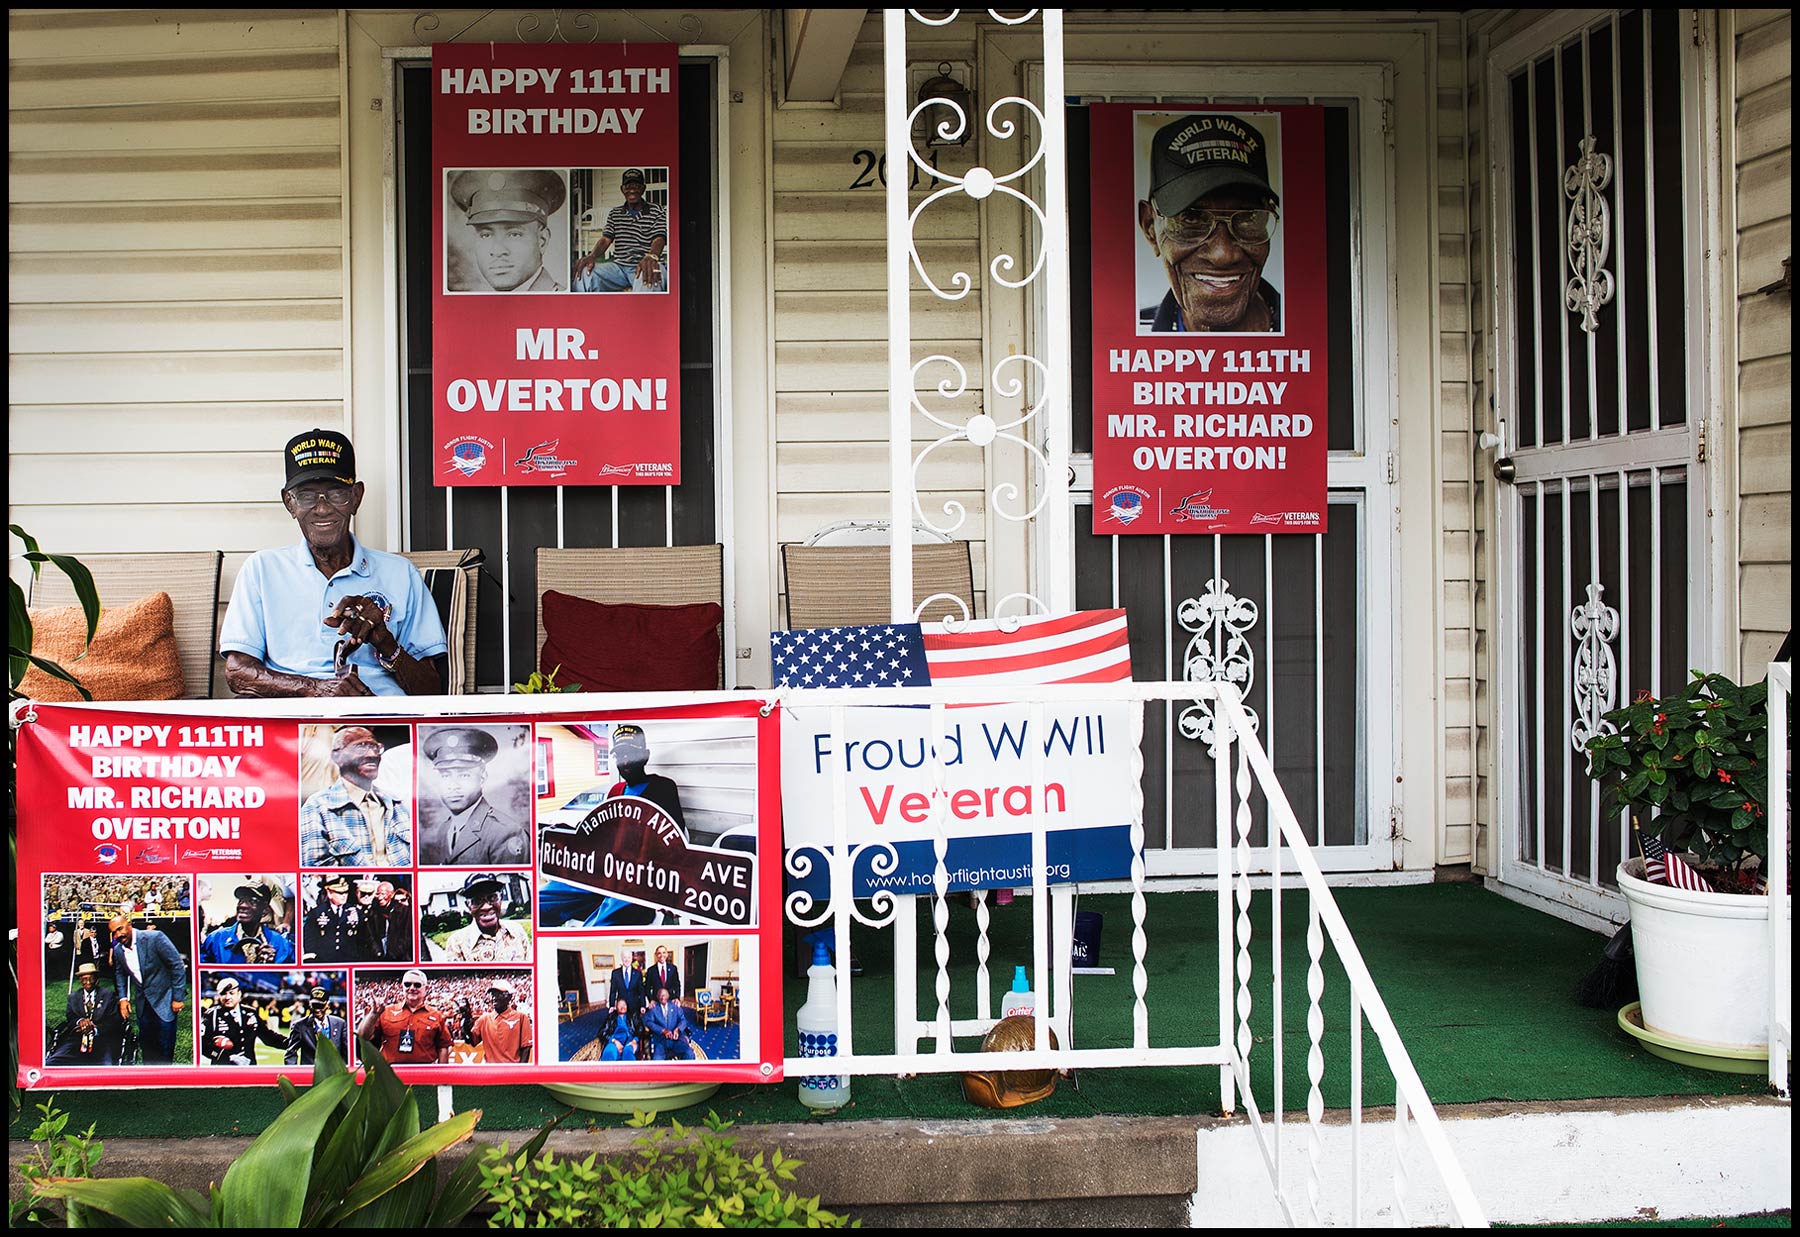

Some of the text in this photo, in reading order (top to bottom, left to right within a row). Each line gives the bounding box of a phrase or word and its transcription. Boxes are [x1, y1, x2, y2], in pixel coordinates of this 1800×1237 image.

[441, 68, 670, 95] HAPPY 111TH
[467, 108, 644, 134] BIRTHDAY
[1168, 118, 1259, 152] WORLD WAR II
[1186, 147, 1249, 164] VETERAN
[516, 327, 599, 360] MR.
[1109, 349, 1311, 373] HAPPY 111TH
[446, 377, 667, 412] OVERTON!
[1133, 381, 1288, 405] BIRTHDAY
[1107, 414, 1313, 438] MR. RICHARD
[291, 438, 343, 456] WORLD WAR II
[1132, 445, 1287, 470] OVERTON!
[297, 457, 336, 467] VETERAN
[69, 725, 264, 748] HAPPY 111TH
[813, 723, 964, 774] Proud
[92, 755, 242, 778] BIRTHDAY
[67, 786, 266, 809] MR. RICHARD
[91, 817, 240, 840] OVERTON!
[581, 802, 680, 846] Hamilton AVE
[543, 842, 681, 894] Richard Overton
[701, 861, 747, 889] AVE
[684, 887, 746, 920] 2000
